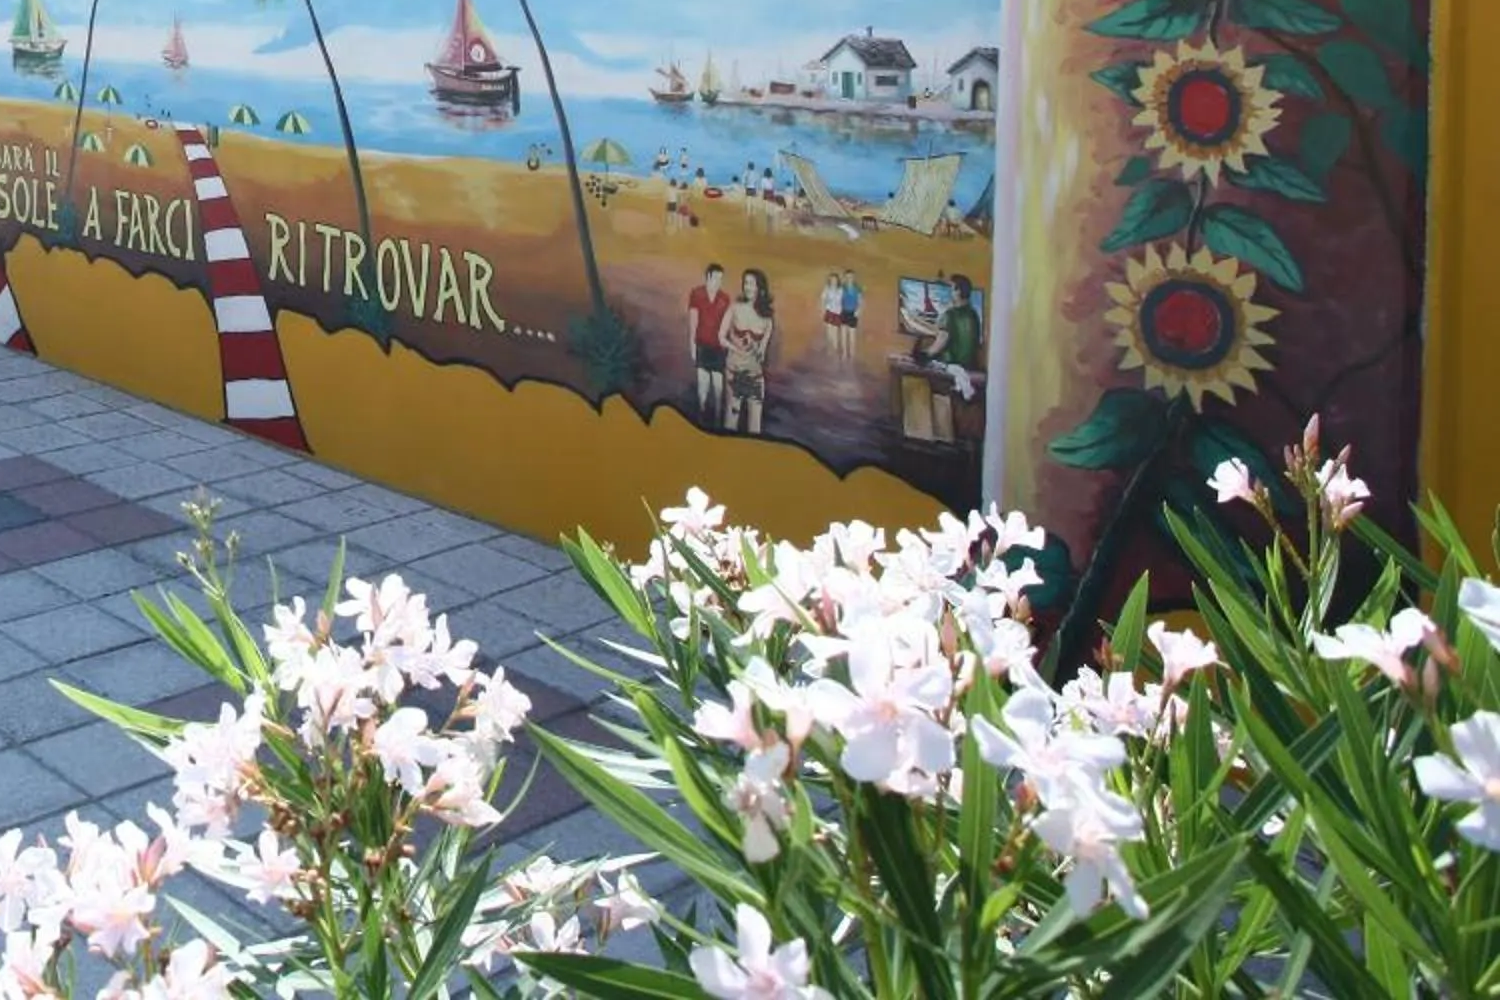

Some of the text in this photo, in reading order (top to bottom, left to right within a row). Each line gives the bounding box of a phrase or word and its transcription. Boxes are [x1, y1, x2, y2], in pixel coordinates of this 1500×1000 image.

[45, 149, 61, 177] IL
[82, 186, 102, 240] A
[113, 189, 195, 261] FARCI
